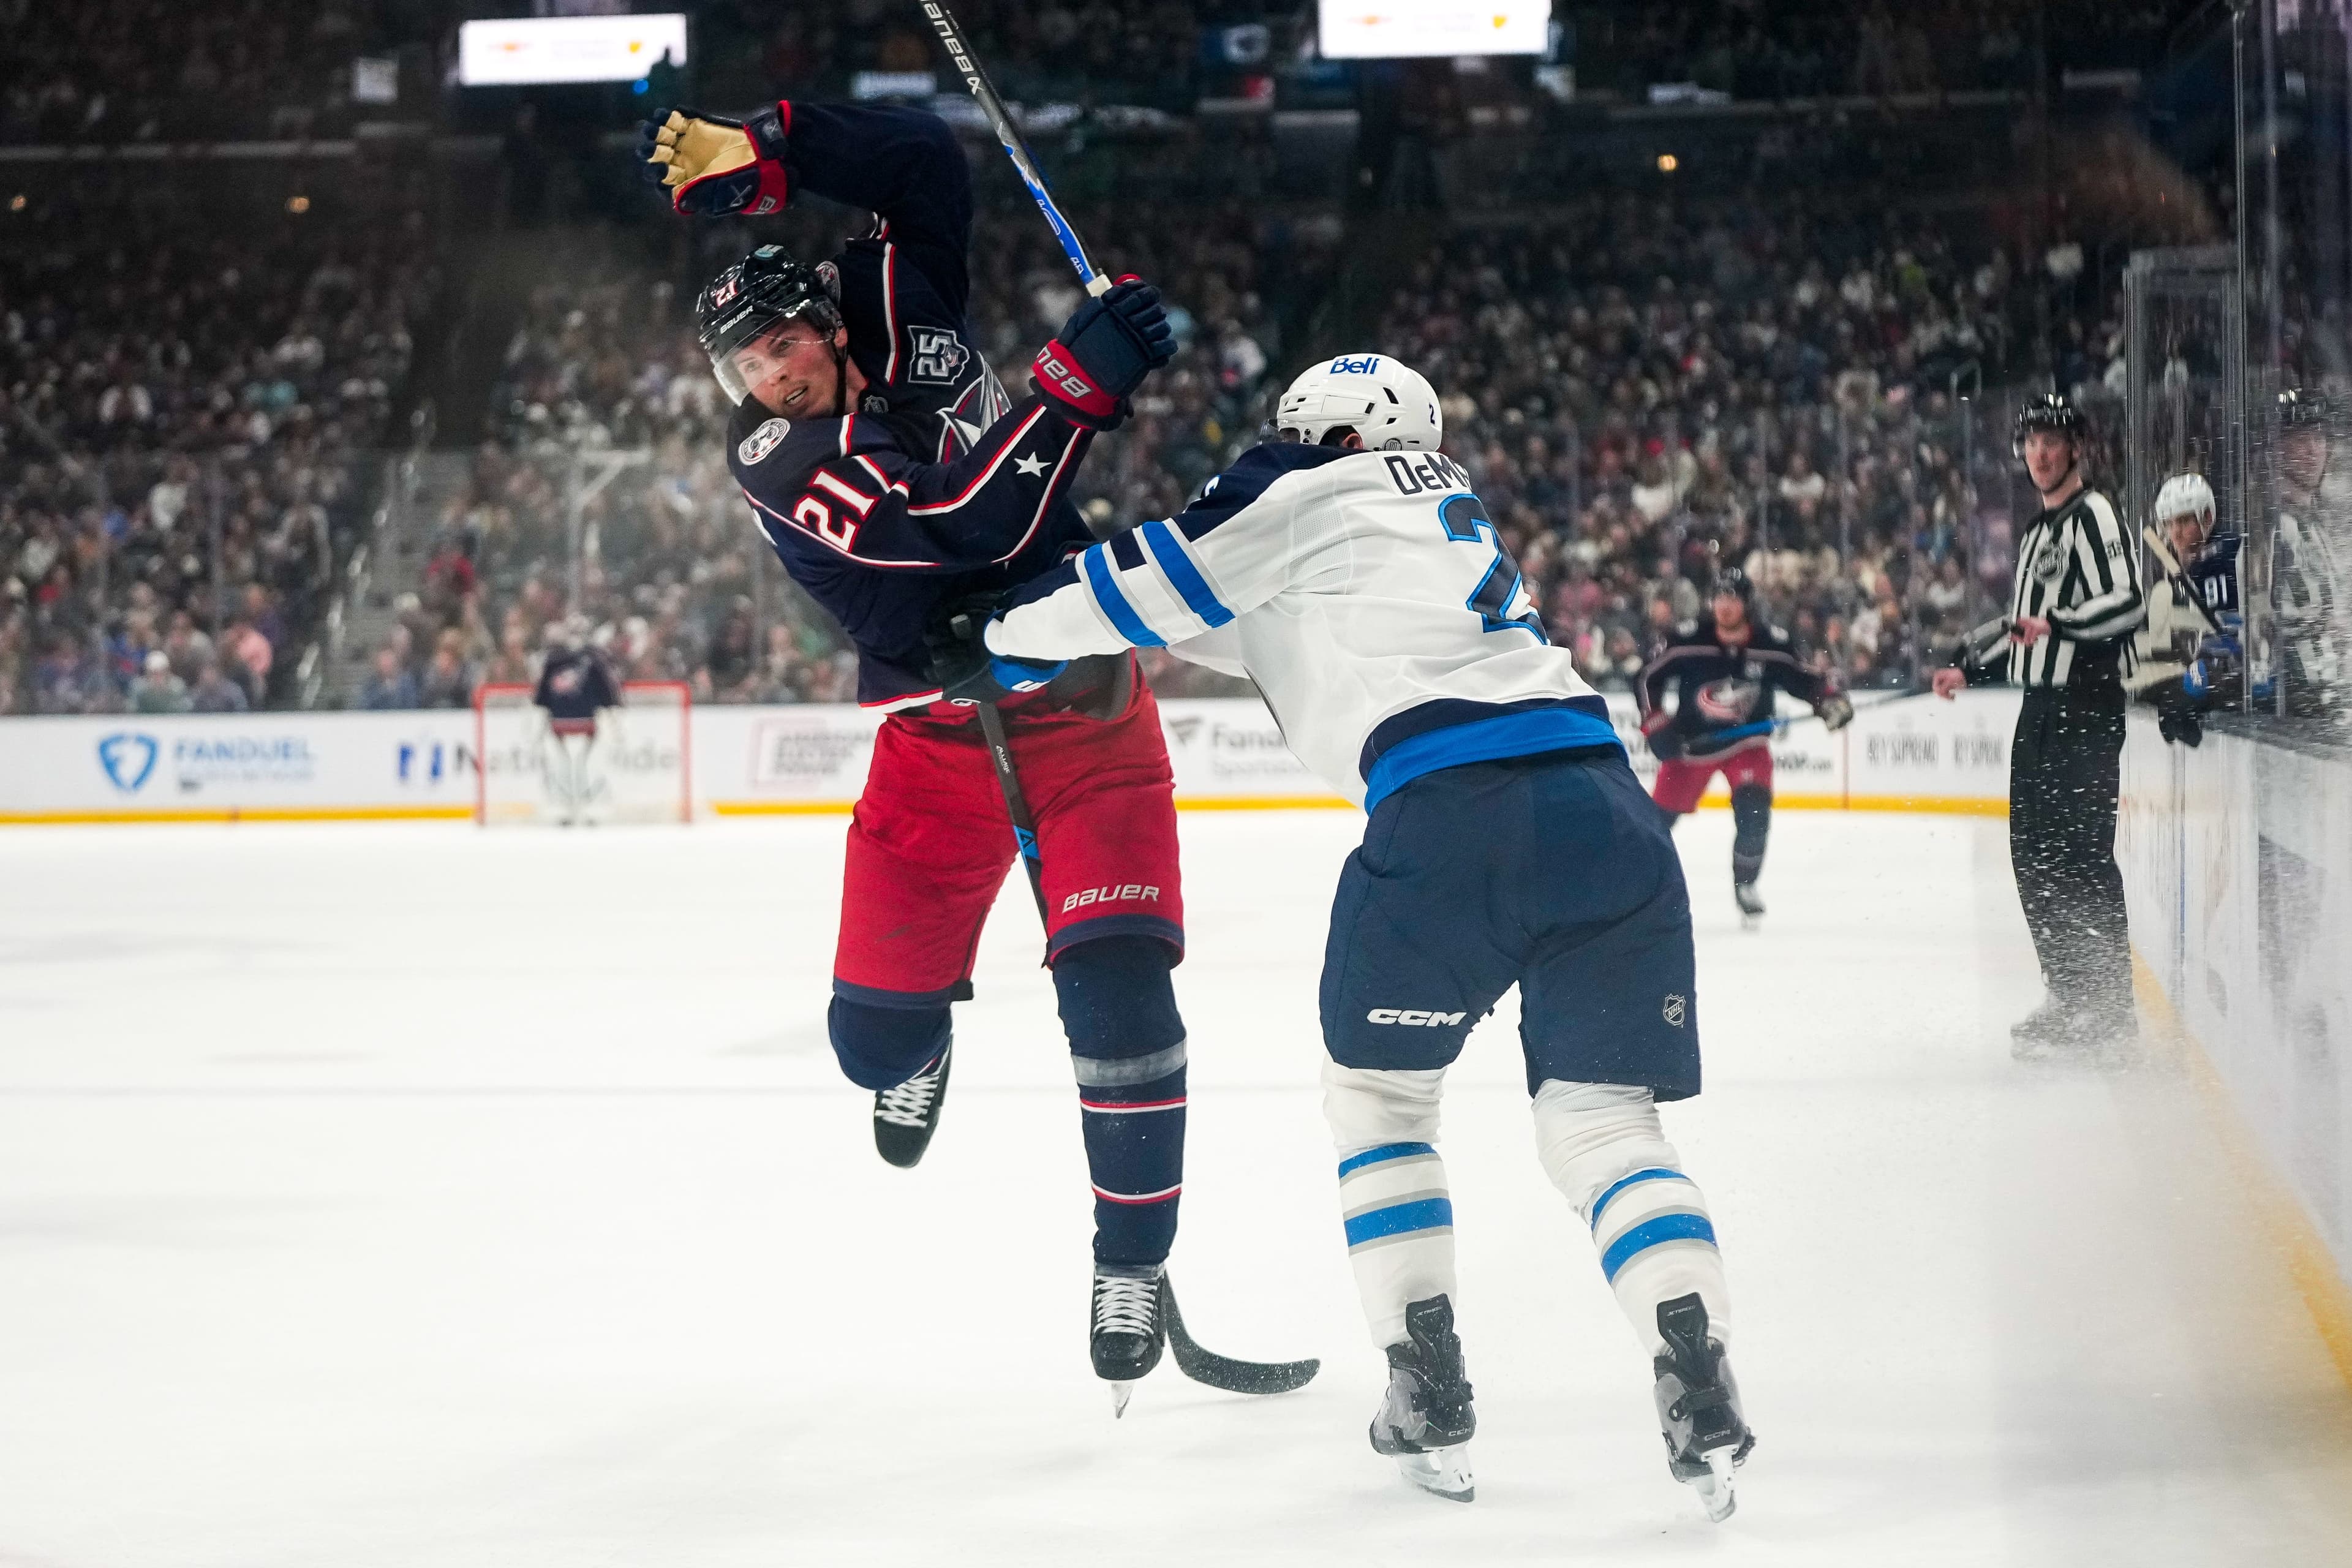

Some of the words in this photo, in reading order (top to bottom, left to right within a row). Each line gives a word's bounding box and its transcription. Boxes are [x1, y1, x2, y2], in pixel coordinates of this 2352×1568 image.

[921, 0, 974, 72] BAUE
[715, 279, 738, 308] 21
[720, 305, 754, 334] BAUER
[918, 334, 951, 377] 25
[1330, 358, 1379, 374] Bell
[1429, 402, 1435, 424] 2
[792, 467, 880, 554] 21
[1438, 493, 1547, 646] 2
[1062, 884, 1159, 913] BAUER
[1366, 1008, 1467, 1027] CCM
[1668, 1004, 1681, 1018] NHL
